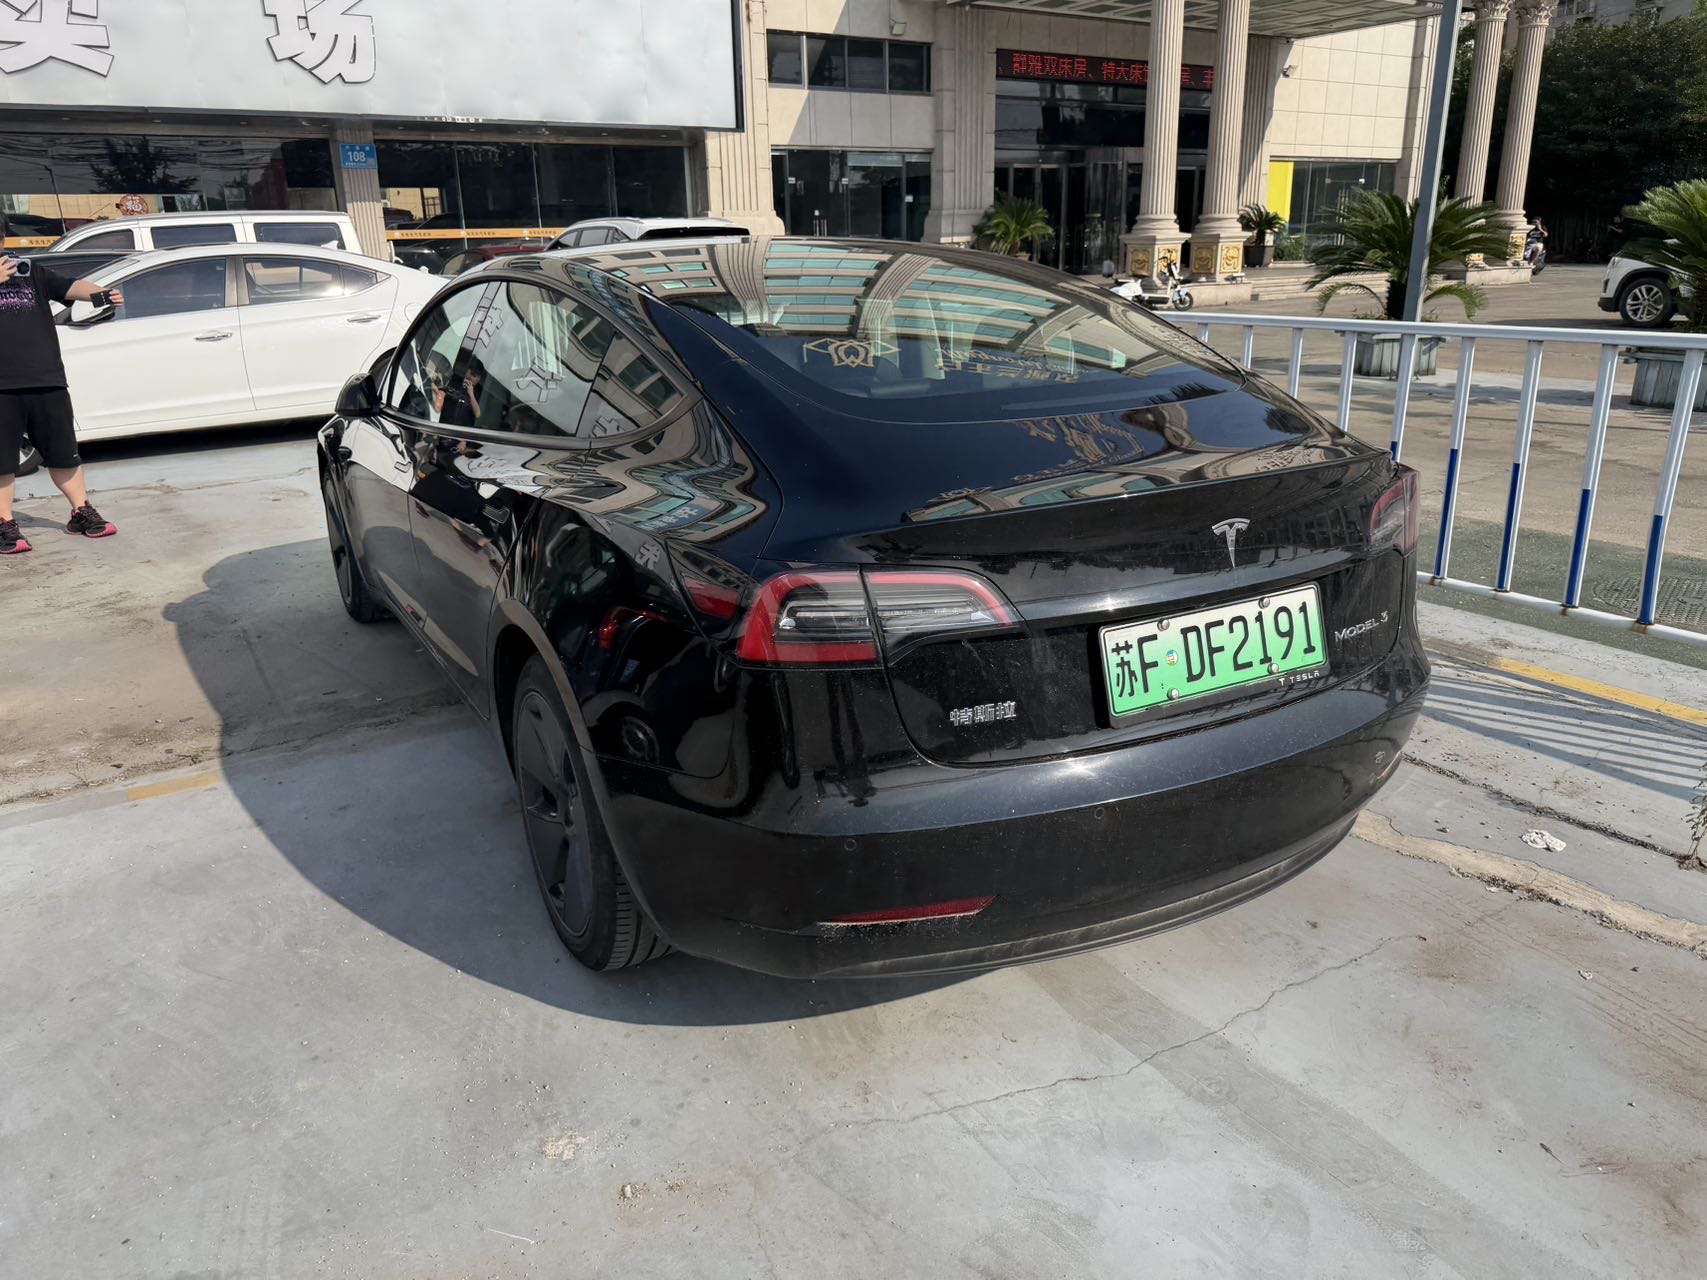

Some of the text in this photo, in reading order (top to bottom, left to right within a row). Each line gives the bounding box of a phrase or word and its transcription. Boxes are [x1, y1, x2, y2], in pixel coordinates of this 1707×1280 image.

[347, 151, 366, 162] 108
[1334, 610, 1389, 642] MODEL 3
[1111, 601, 1317, 698] 苏F DF2191
[1289, 670, 1320, 684] TESLA
[949, 700, 1017, 726] 特斯拉
